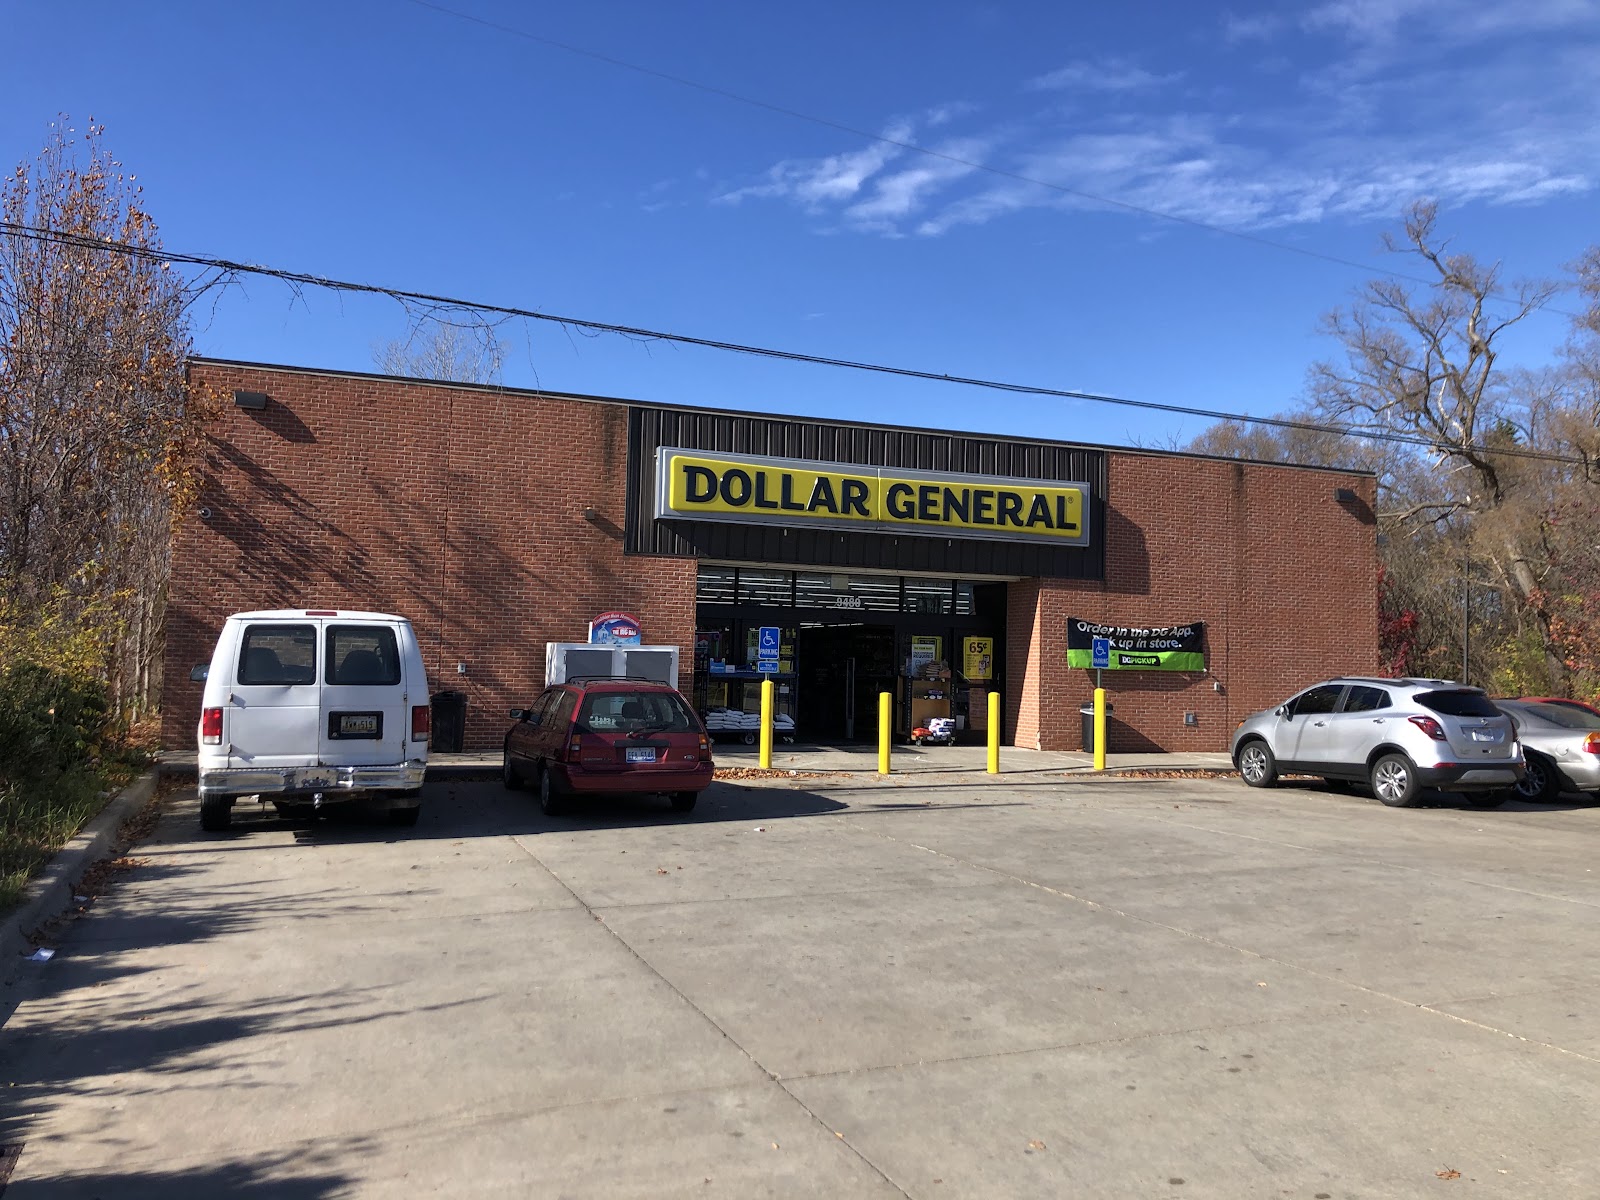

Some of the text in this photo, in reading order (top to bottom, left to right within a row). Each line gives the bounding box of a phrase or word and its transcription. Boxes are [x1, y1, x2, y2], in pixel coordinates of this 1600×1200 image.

[683, 465, 1078, 530] DOLLAR GENERAL
[1077, 621, 1195, 638] Order in the DG App.
[969, 641, 988, 654] 65¢
[1118, 640, 1134, 650] up
[1136, 639, 1147, 648] in
[1149, 639, 1182, 649] store.
[760, 648, 778, 656] PARKING
